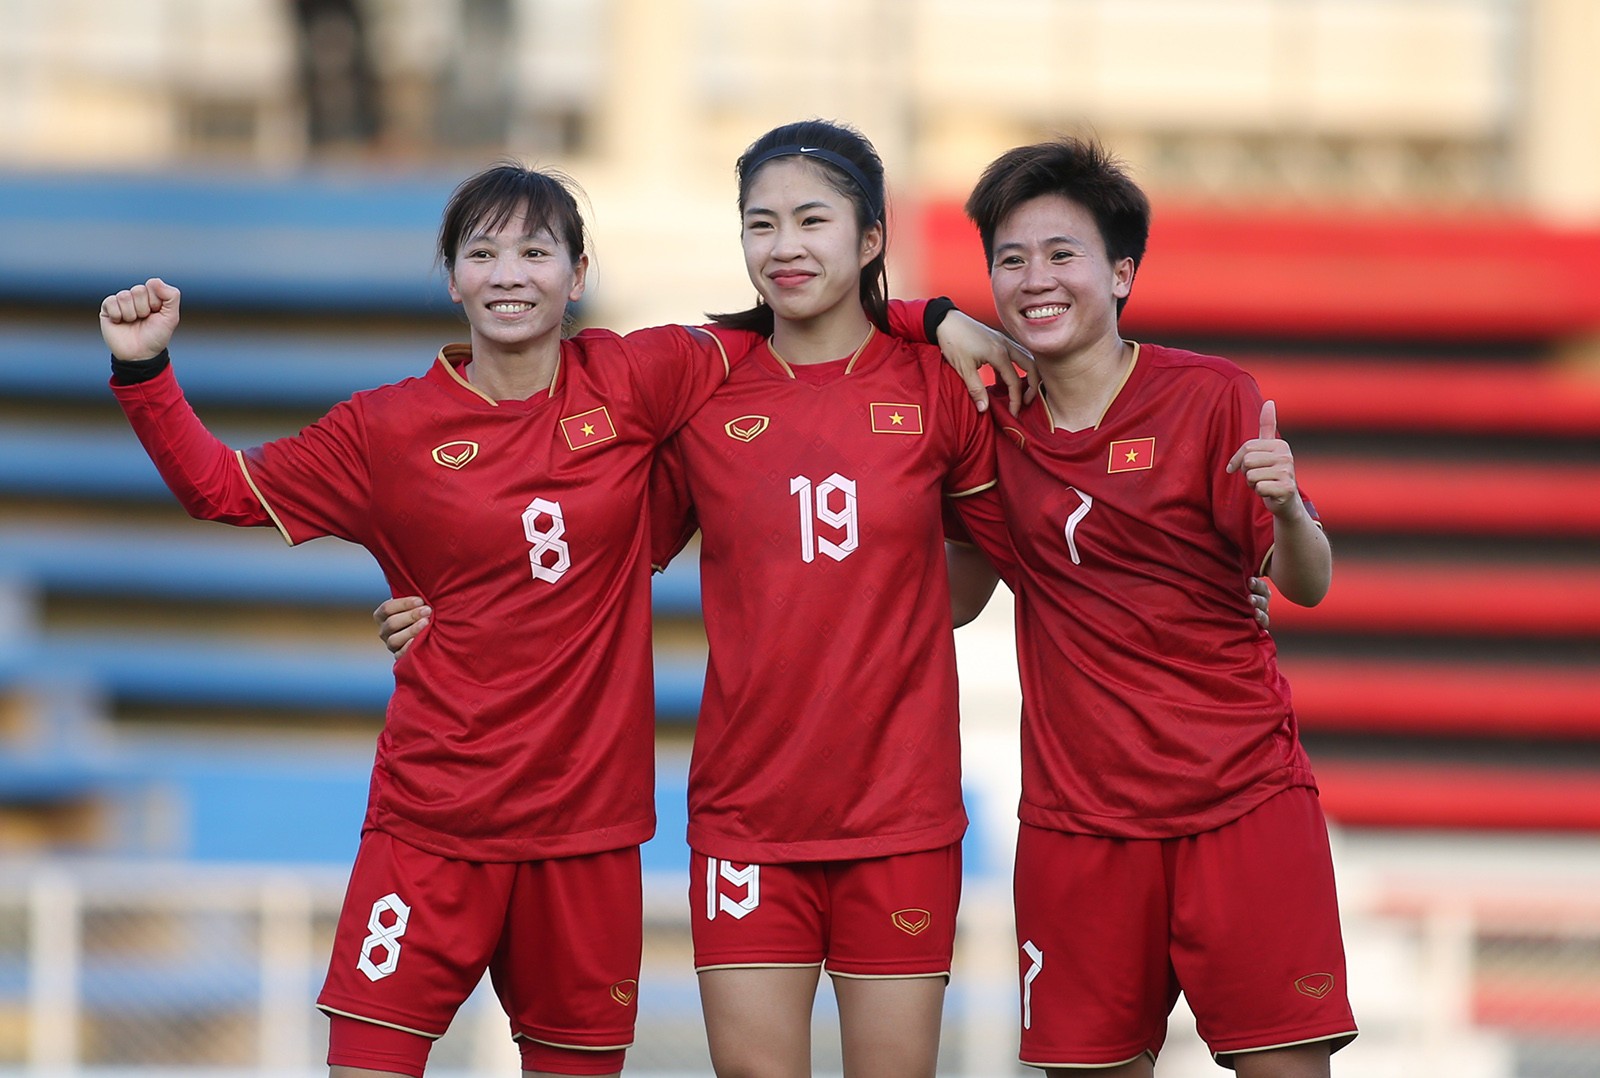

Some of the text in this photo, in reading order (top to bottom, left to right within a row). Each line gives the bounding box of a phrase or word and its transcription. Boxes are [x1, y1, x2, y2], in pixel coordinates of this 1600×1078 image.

[521, 497, 571, 584] 8
[790, 473, 859, 564] 19
[1064, 486, 1093, 565] 7
[706, 856, 760, 921] 19
[356, 892, 411, 982] 8
[1021, 940, 1043, 1030] 7
